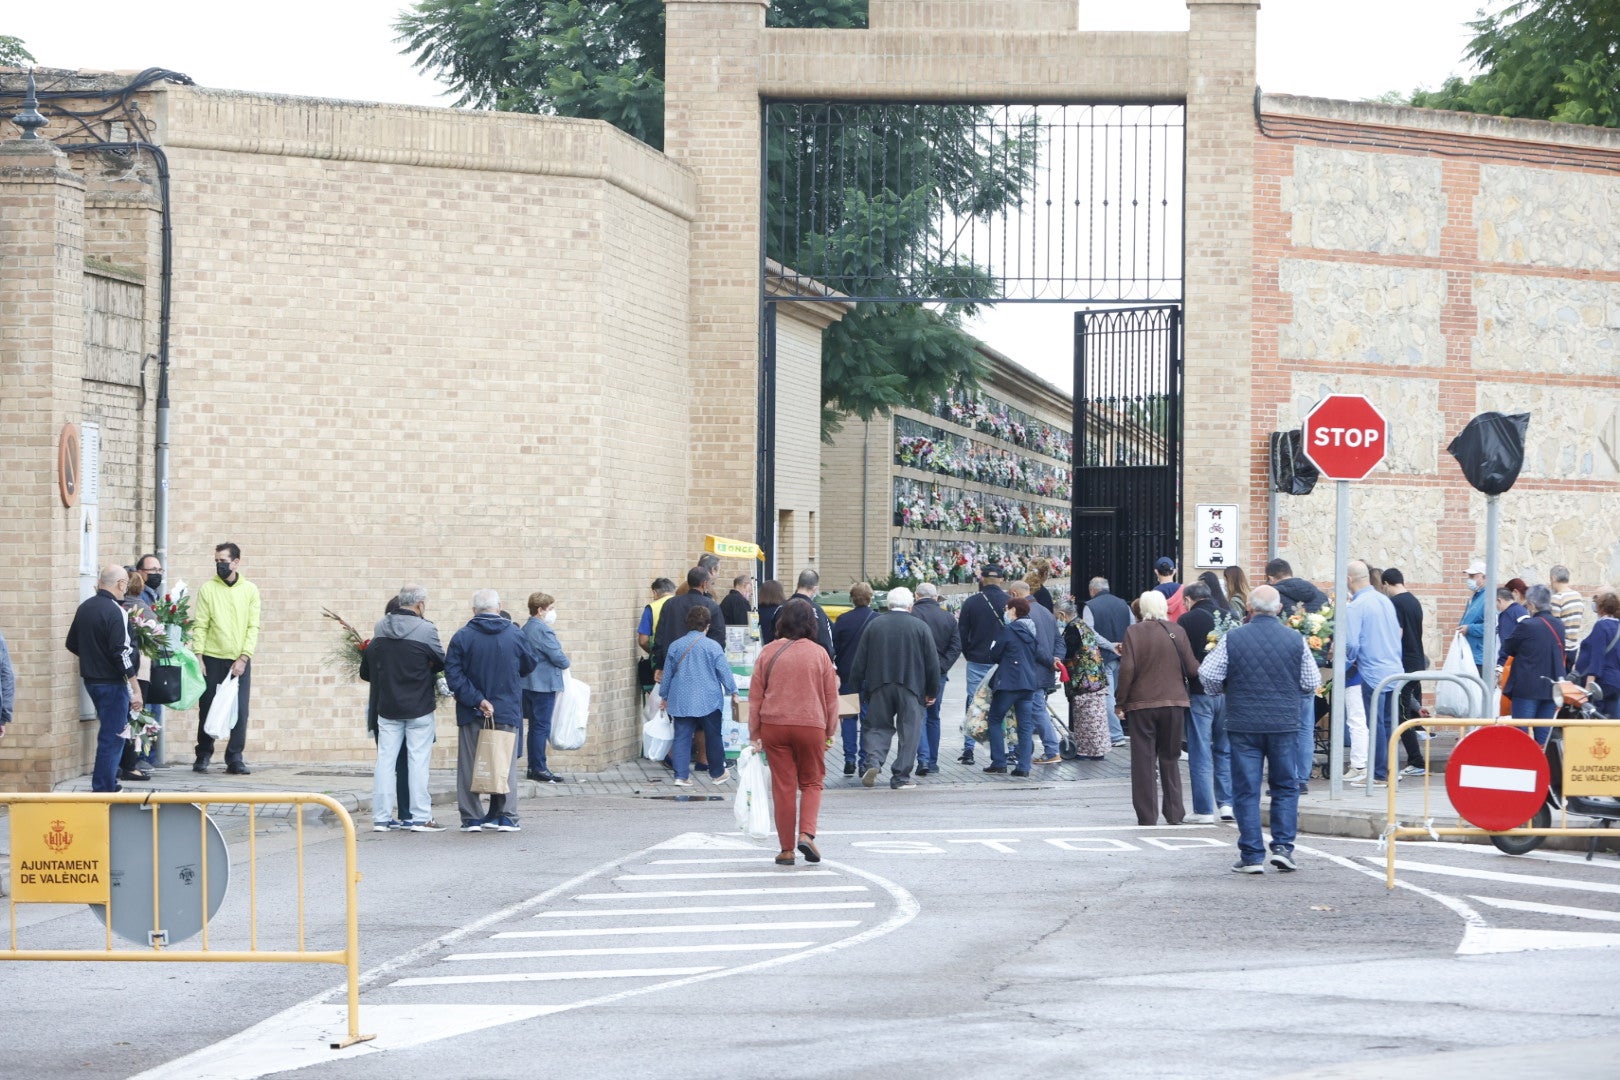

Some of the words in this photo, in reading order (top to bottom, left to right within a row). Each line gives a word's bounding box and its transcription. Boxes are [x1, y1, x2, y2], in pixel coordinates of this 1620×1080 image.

[1313, 426, 1379, 448] STOP
[727, 545, 754, 553] ONCE
[1571, 774, 1583, 782] DE
[850, 836, 1232, 854] STOP
[20, 860, 100, 871] AJUNTAMENT
[20, 873, 37, 884] DE
[40, 871, 100, 884] VALÈNCIA
